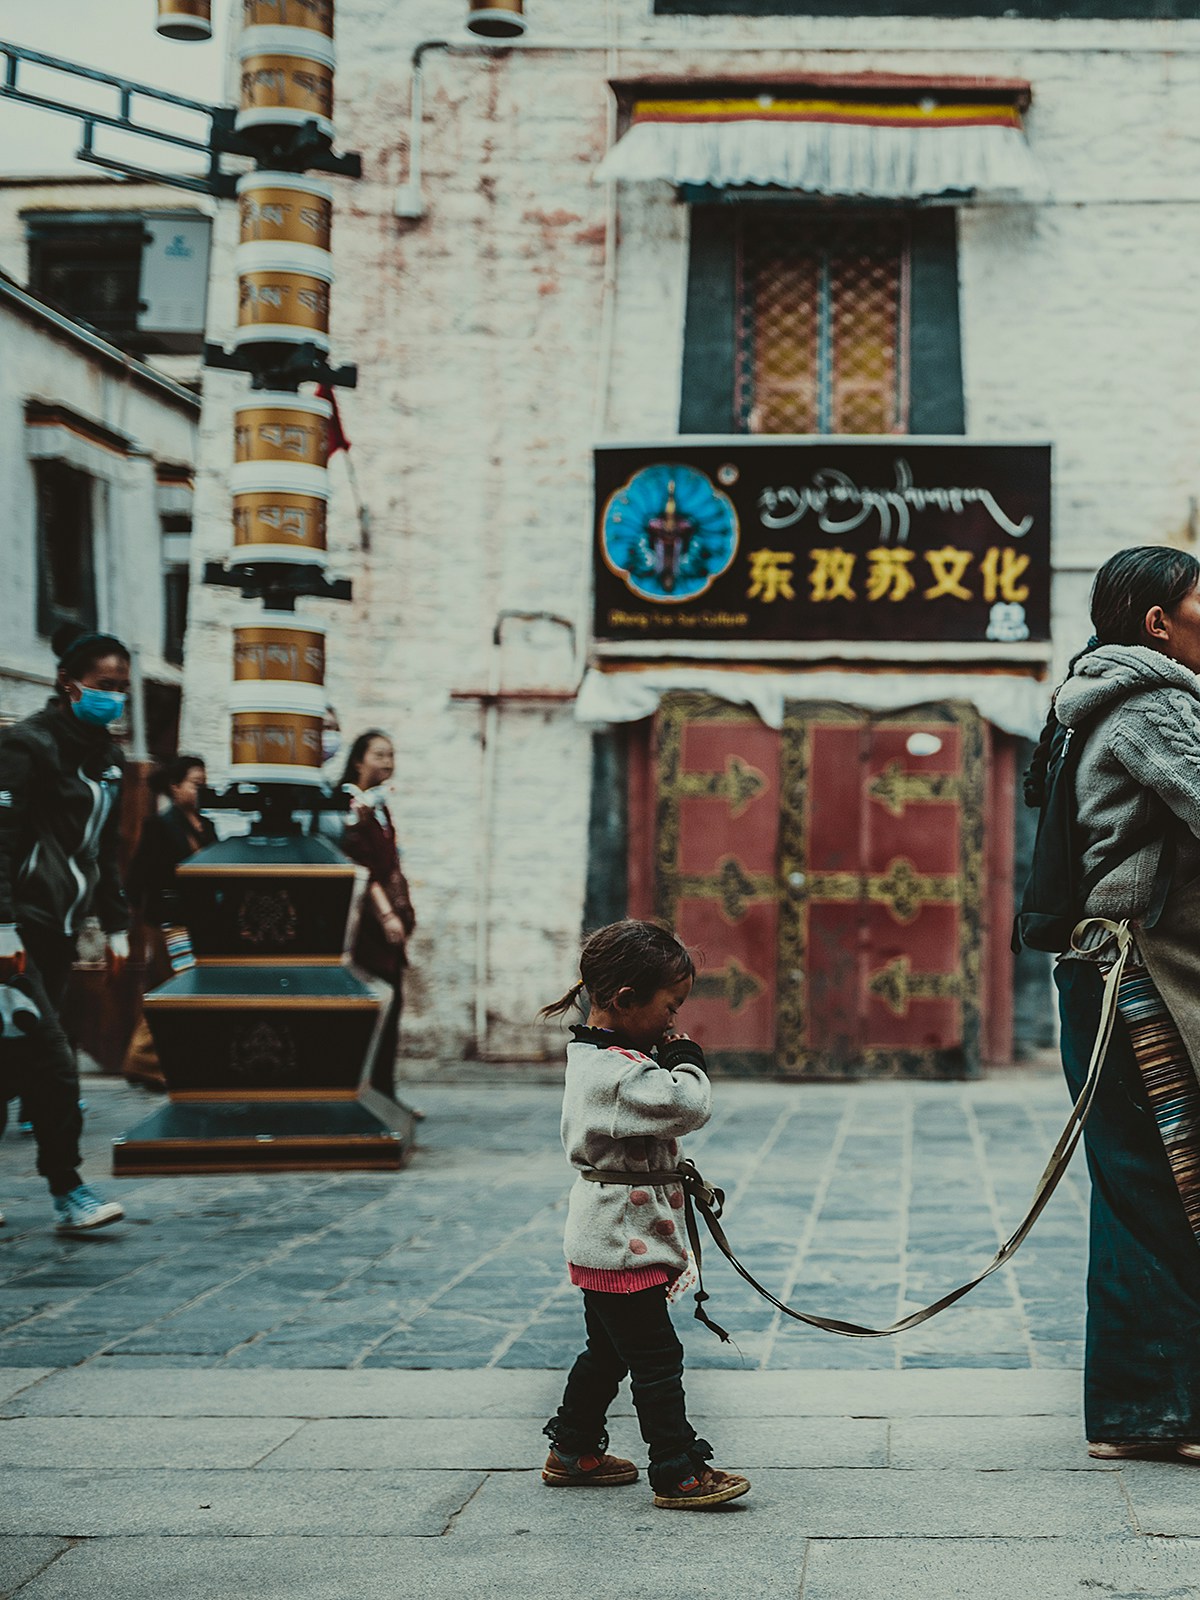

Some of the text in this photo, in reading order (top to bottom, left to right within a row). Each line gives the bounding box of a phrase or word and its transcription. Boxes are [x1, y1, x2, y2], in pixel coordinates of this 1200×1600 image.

[746, 545, 1030, 602] 东孜苏文化
